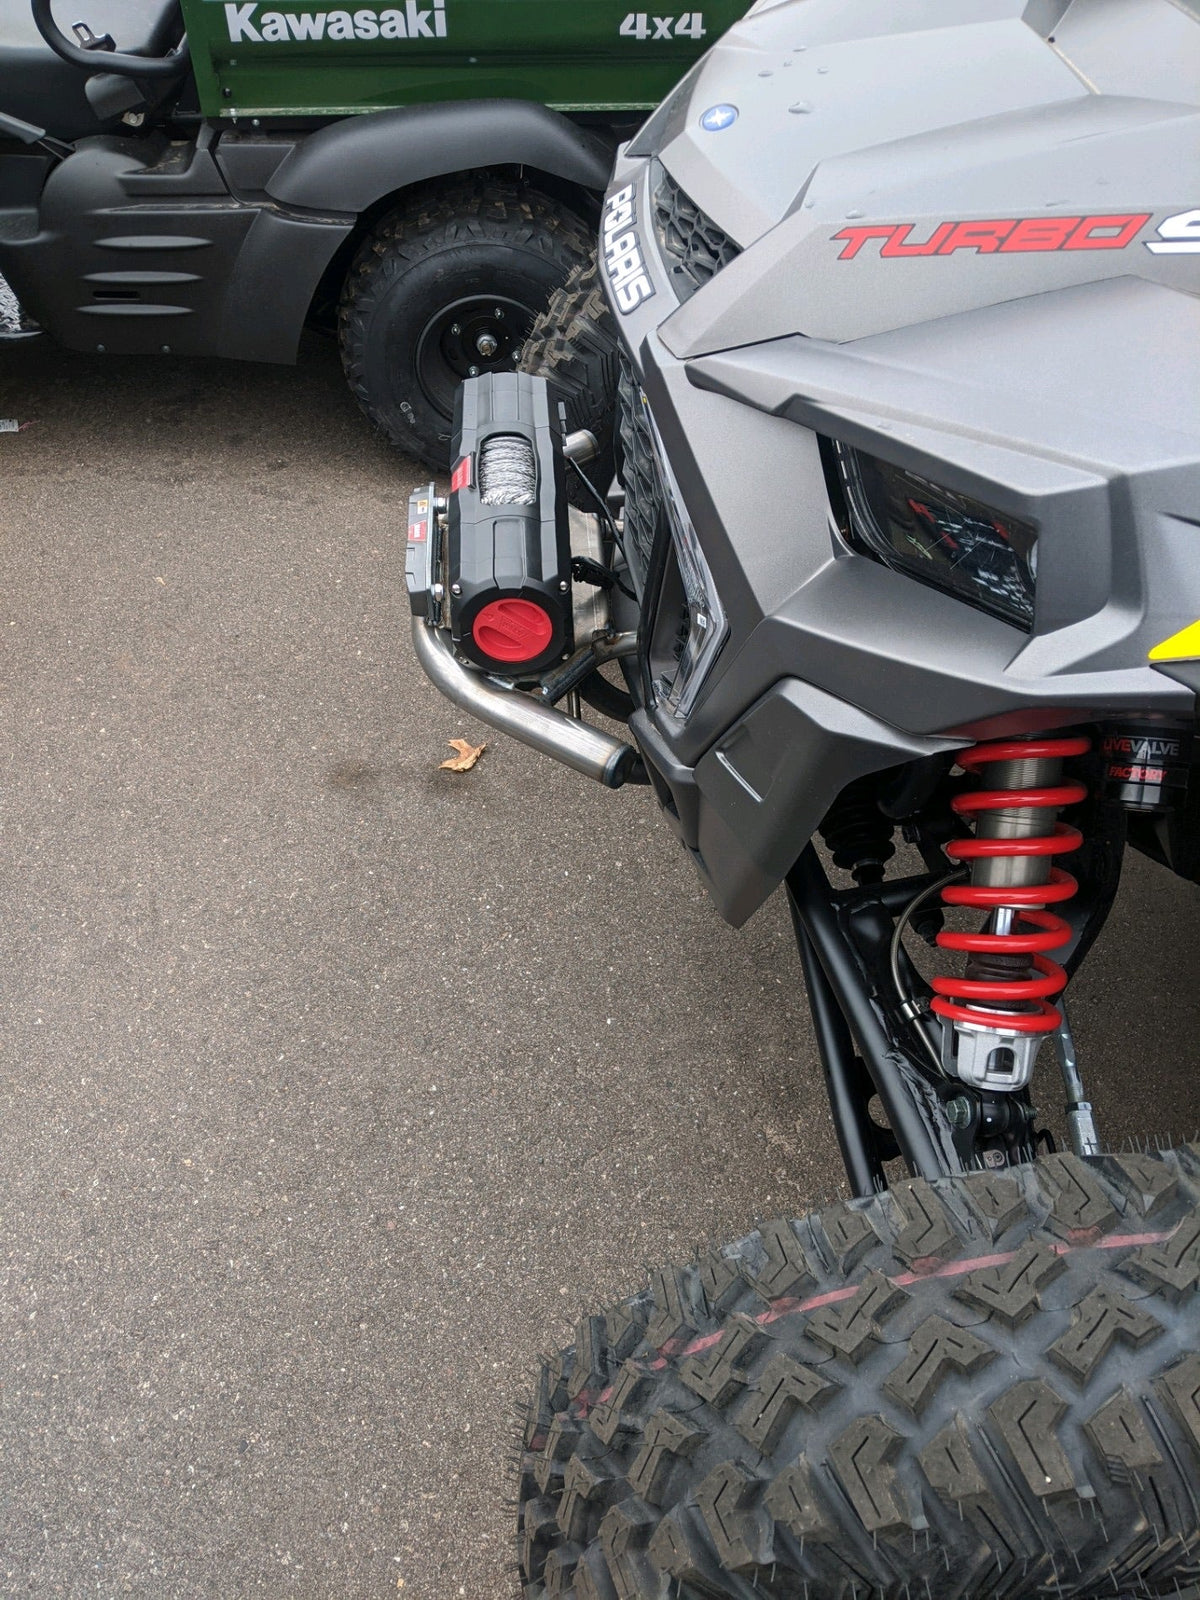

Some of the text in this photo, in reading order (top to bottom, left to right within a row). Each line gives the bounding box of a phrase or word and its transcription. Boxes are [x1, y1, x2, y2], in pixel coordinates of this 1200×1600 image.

[224, 0, 447, 42] Kawasaki
[620, 12, 706, 39] 4x4
[604, 183, 653, 313] POLARIS
[831, 213, 1152, 260] TURBO
[1108, 766, 1168, 781] FACTORY
